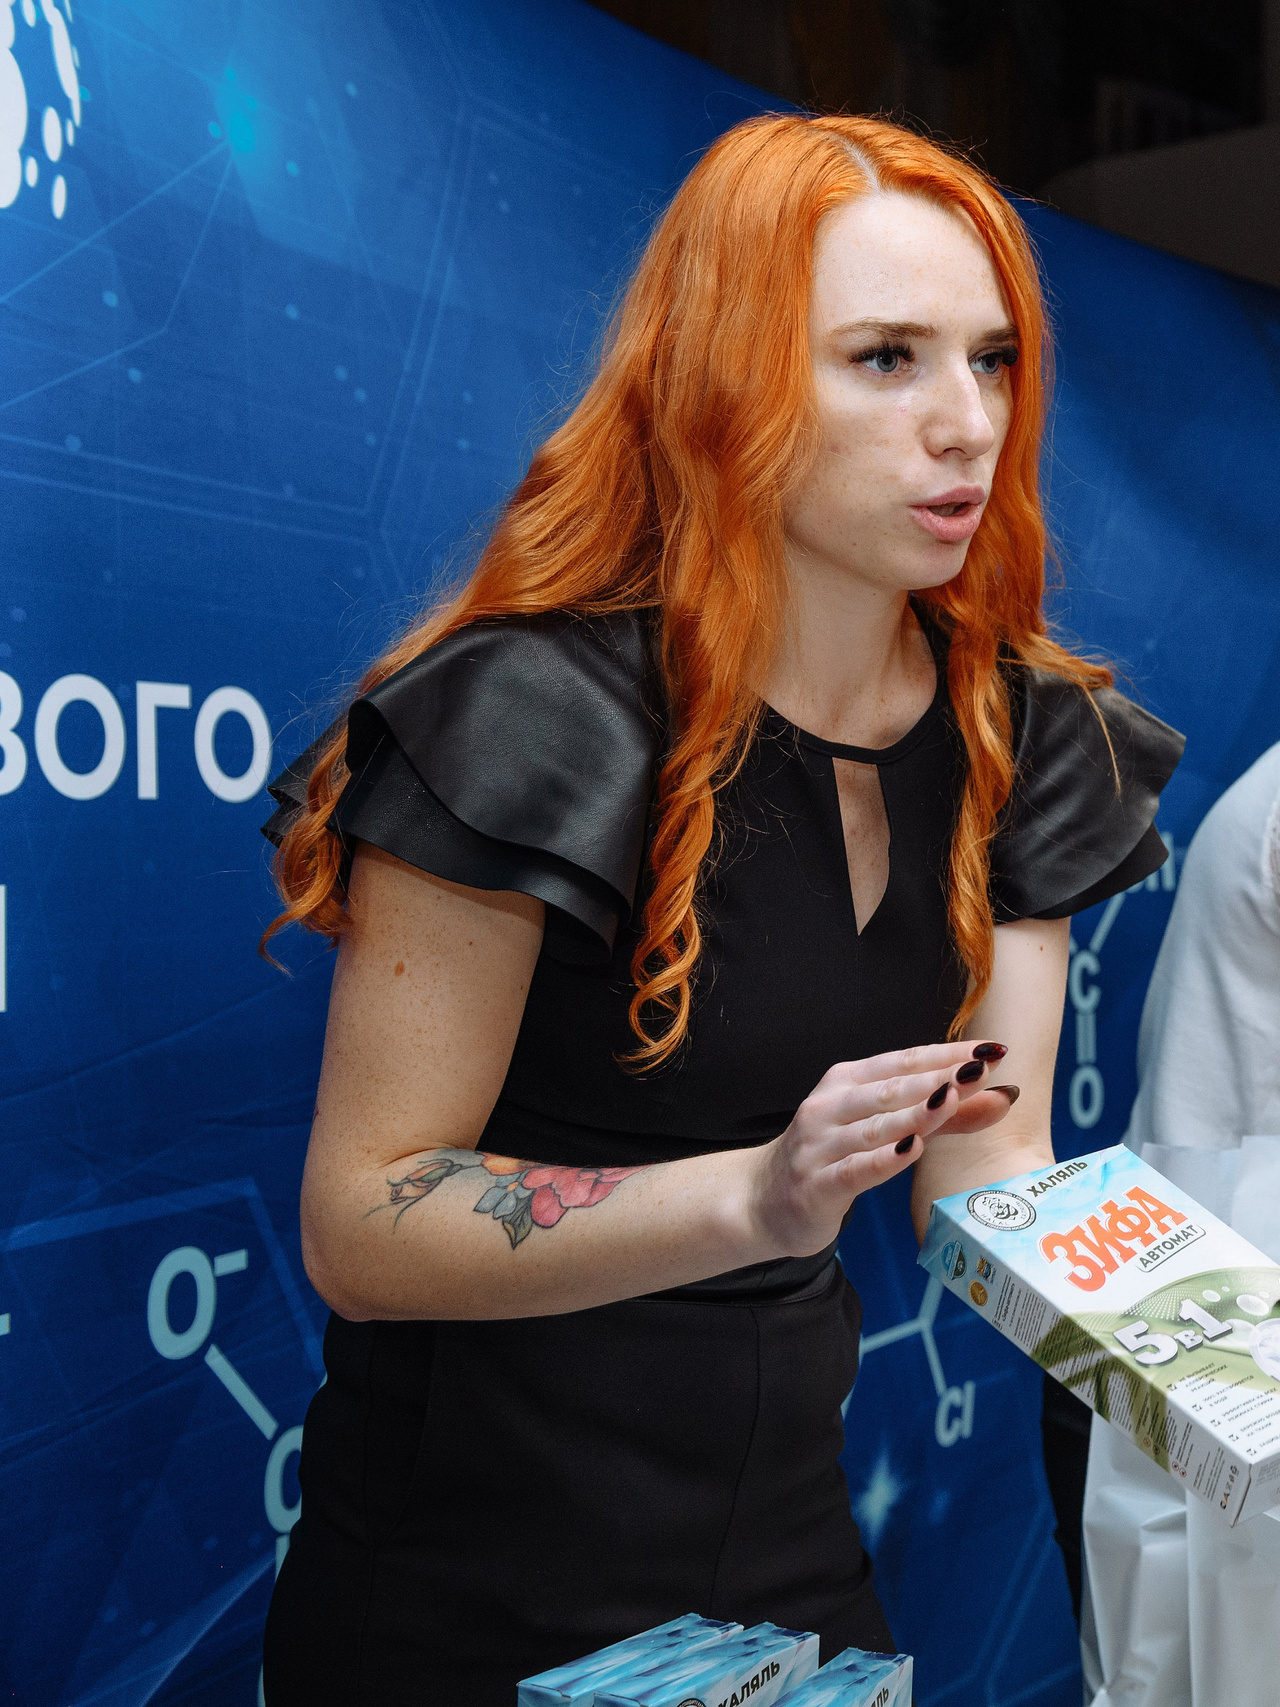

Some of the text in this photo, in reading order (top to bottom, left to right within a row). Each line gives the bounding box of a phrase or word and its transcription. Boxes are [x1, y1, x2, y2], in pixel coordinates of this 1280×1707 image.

[1026, 1159, 1089, 1198] ХАЛЯЛЬ
[1038, 1185, 1189, 1293] ЗИФА
[1138, 1224, 1199, 1269] АВТОМАТ
